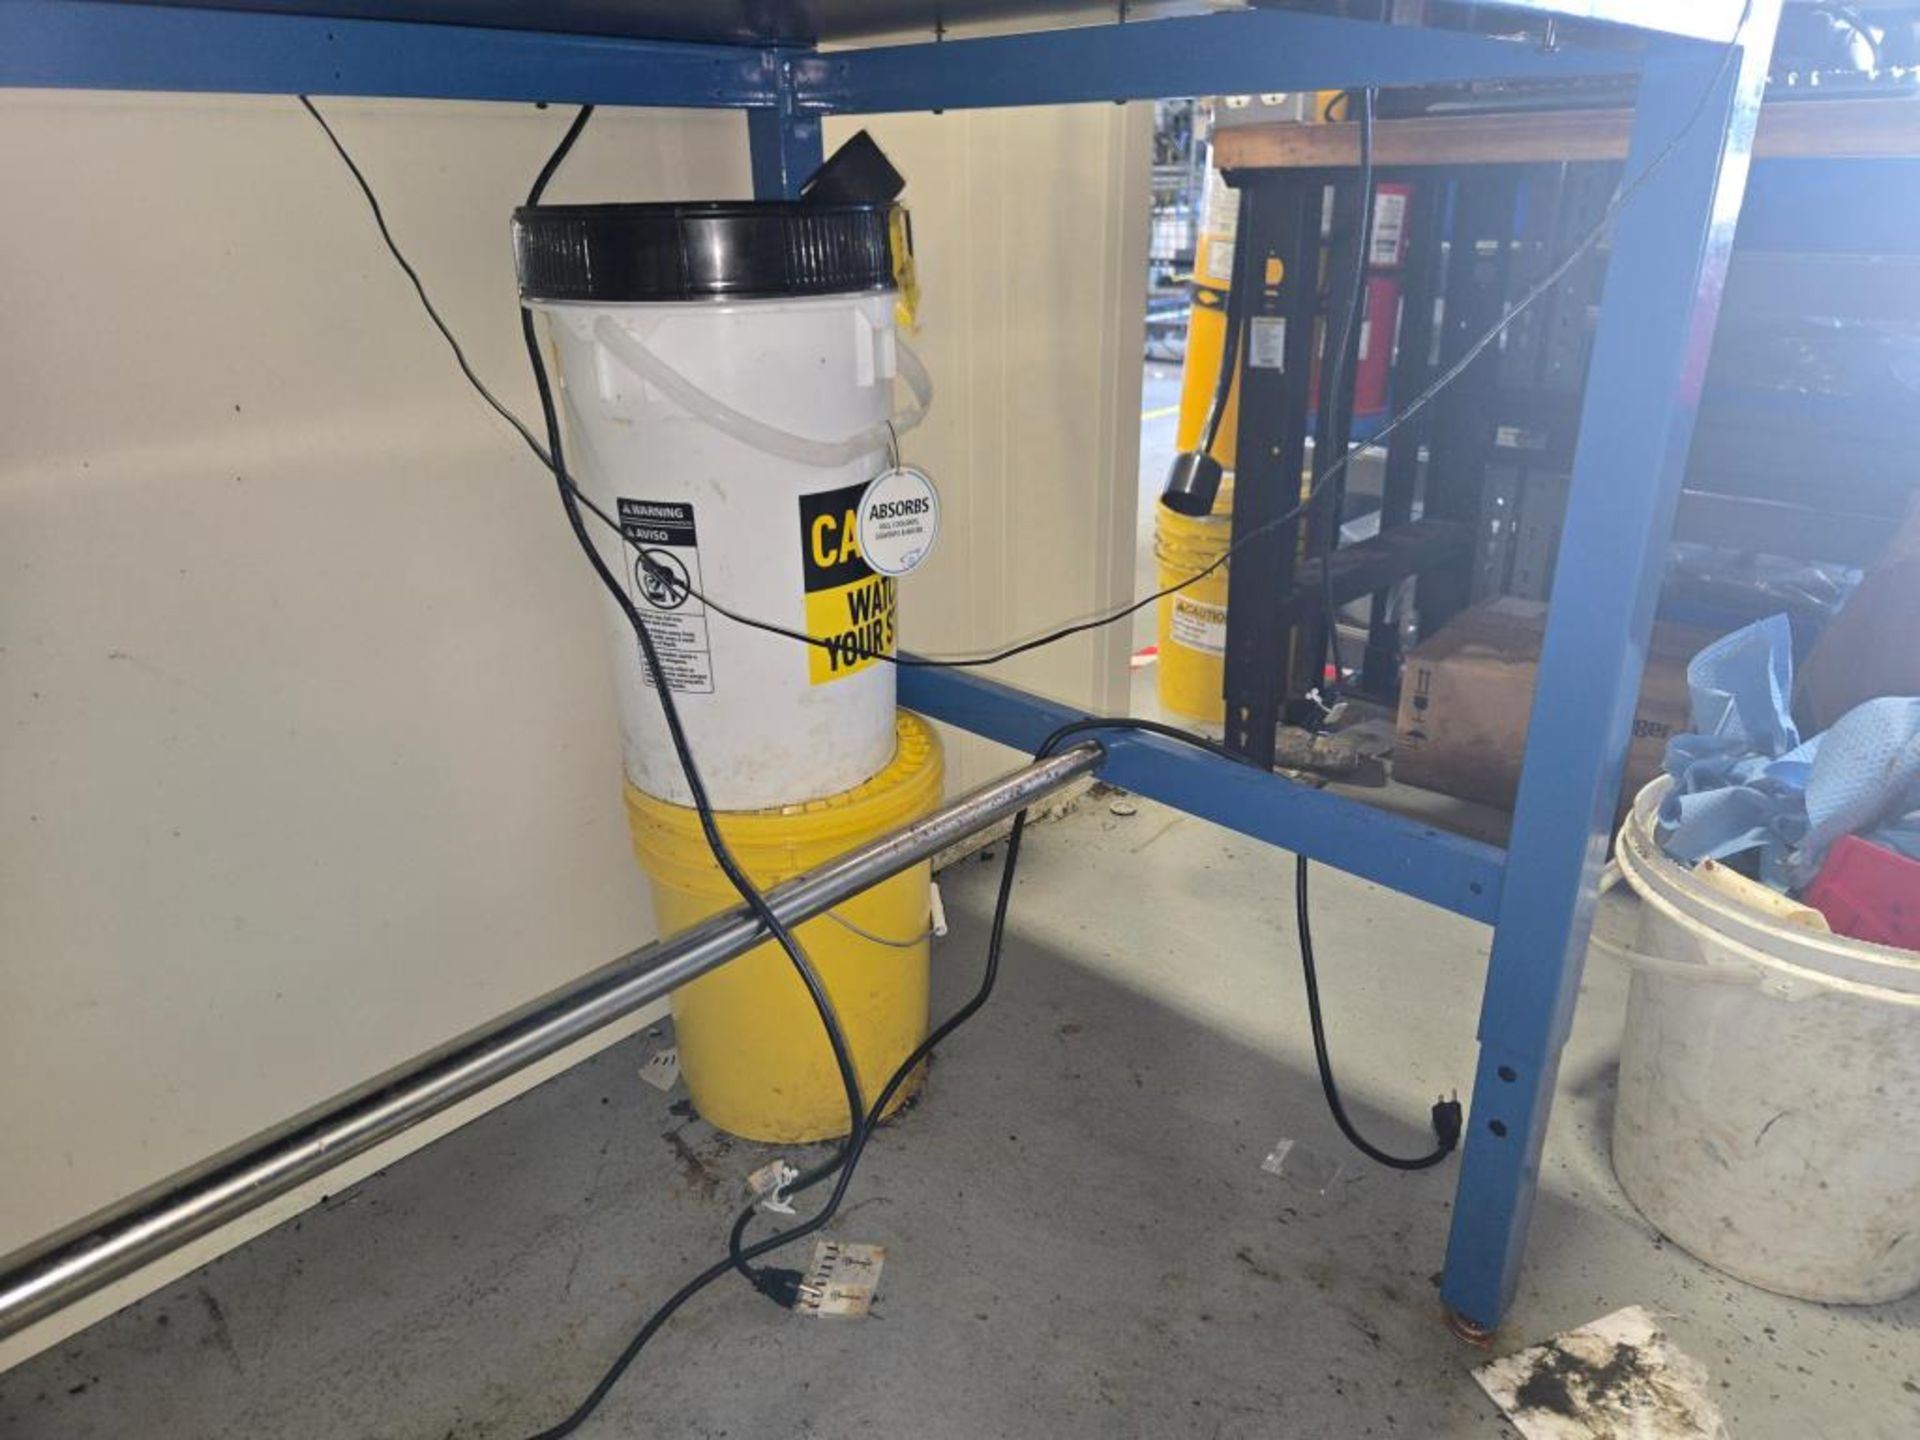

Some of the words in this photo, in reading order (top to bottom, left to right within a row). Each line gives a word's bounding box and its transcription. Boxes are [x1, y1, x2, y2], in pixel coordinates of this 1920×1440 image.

[631, 503, 684, 519] WARNING
[869, 496, 929, 521] ABSORBS
[636, 527, 669, 541] AVISO
[811, 509, 863, 568] CA
[847, 575, 896, 627] WATC
[1186, 602, 1226, 625] CAUTIO
[824, 618, 884, 672] YOUR
[1631, 719, 1672, 739] ger
